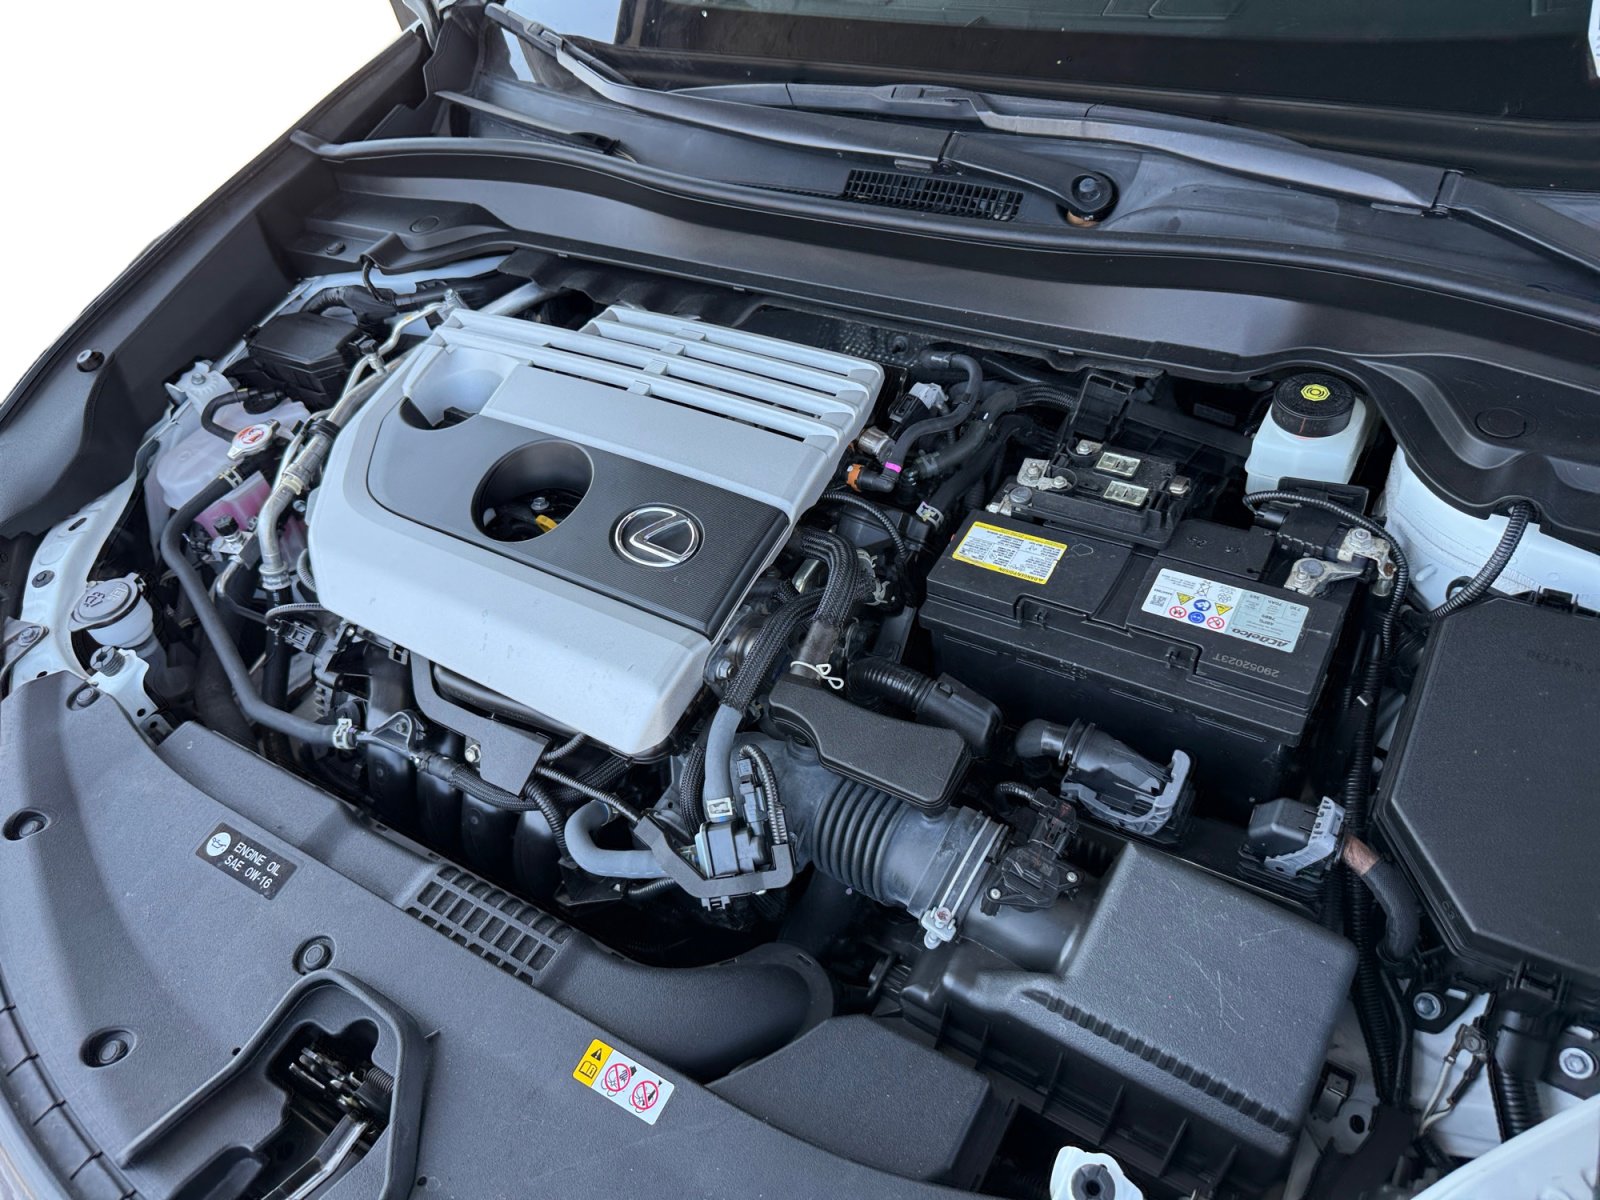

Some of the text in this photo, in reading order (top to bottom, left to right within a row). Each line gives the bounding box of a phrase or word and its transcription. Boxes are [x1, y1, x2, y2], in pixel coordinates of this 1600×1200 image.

[1232, 628, 1290, 648] ACDelco
[1212, 653, 1280, 678] 29052023T
[224, 855, 273, 888] SAE 0W-16
[234, 841, 281, 876] ENGINE OIL
